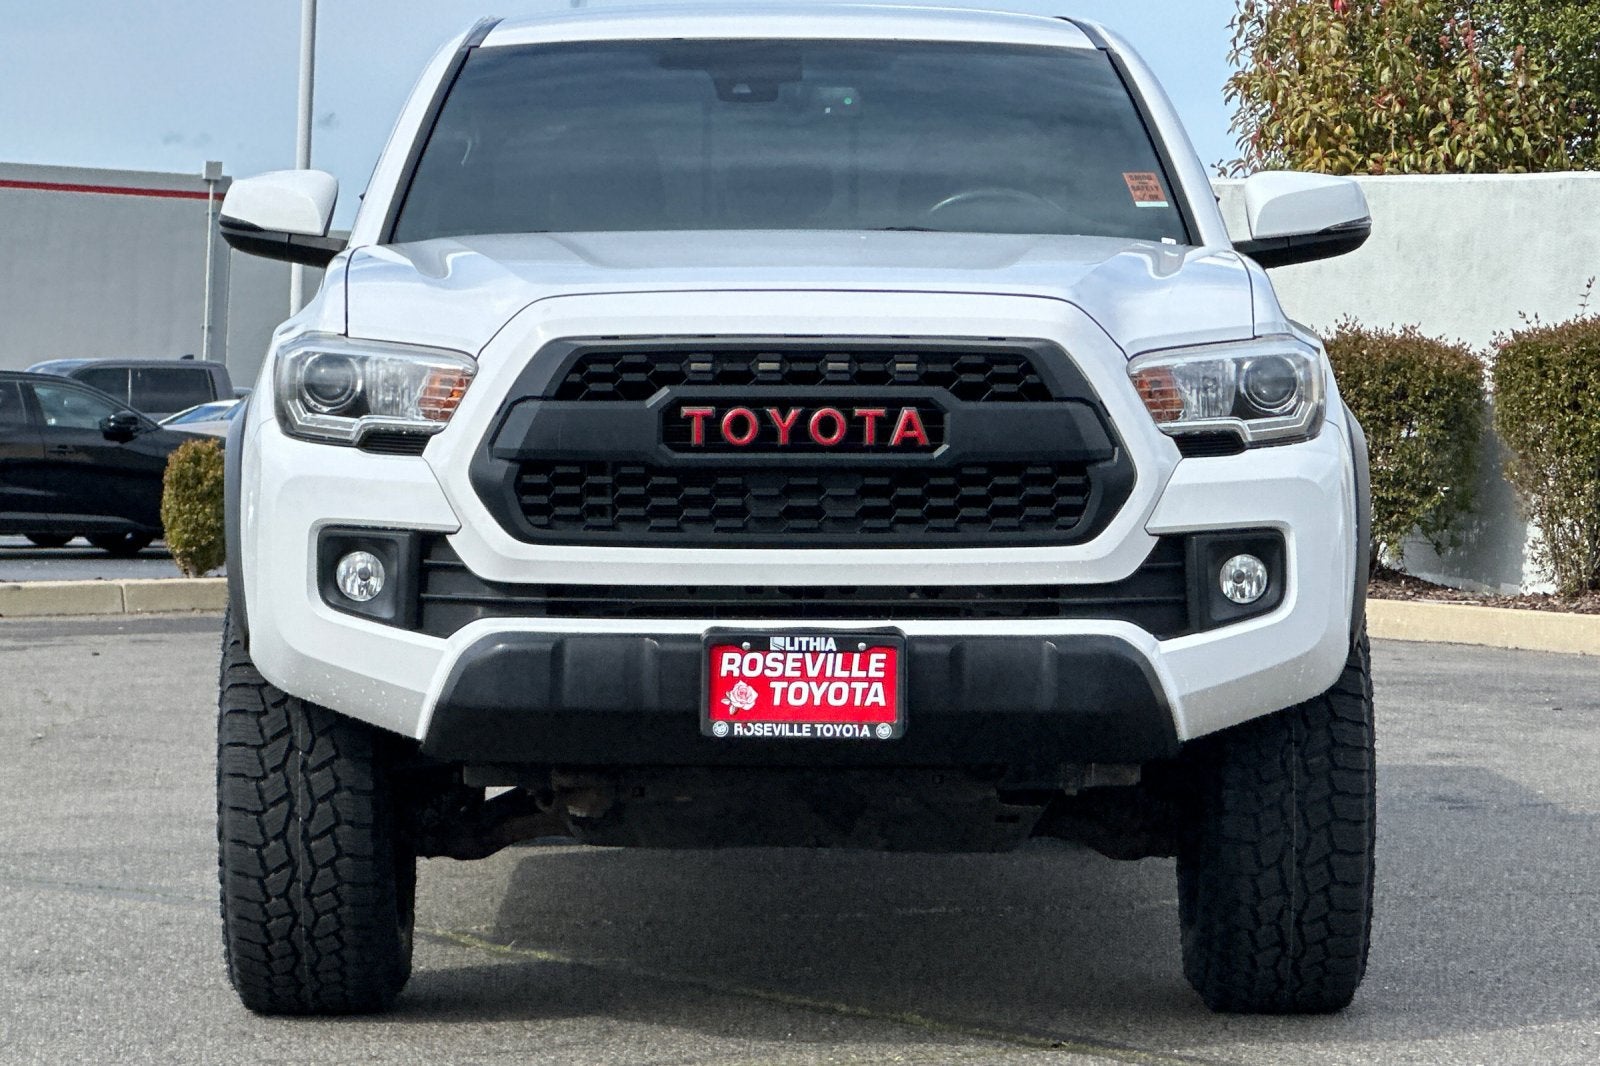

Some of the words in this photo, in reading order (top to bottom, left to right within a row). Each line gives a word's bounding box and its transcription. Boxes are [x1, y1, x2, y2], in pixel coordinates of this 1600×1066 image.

[680, 406, 930, 447] TOYOTA
[784, 636, 837, 651] LITHIA
[720, 652, 887, 678] ROSEVILLE
[769, 681, 887, 707] TOYOTA
[733, 723, 811, 737] ROSEVILLE
